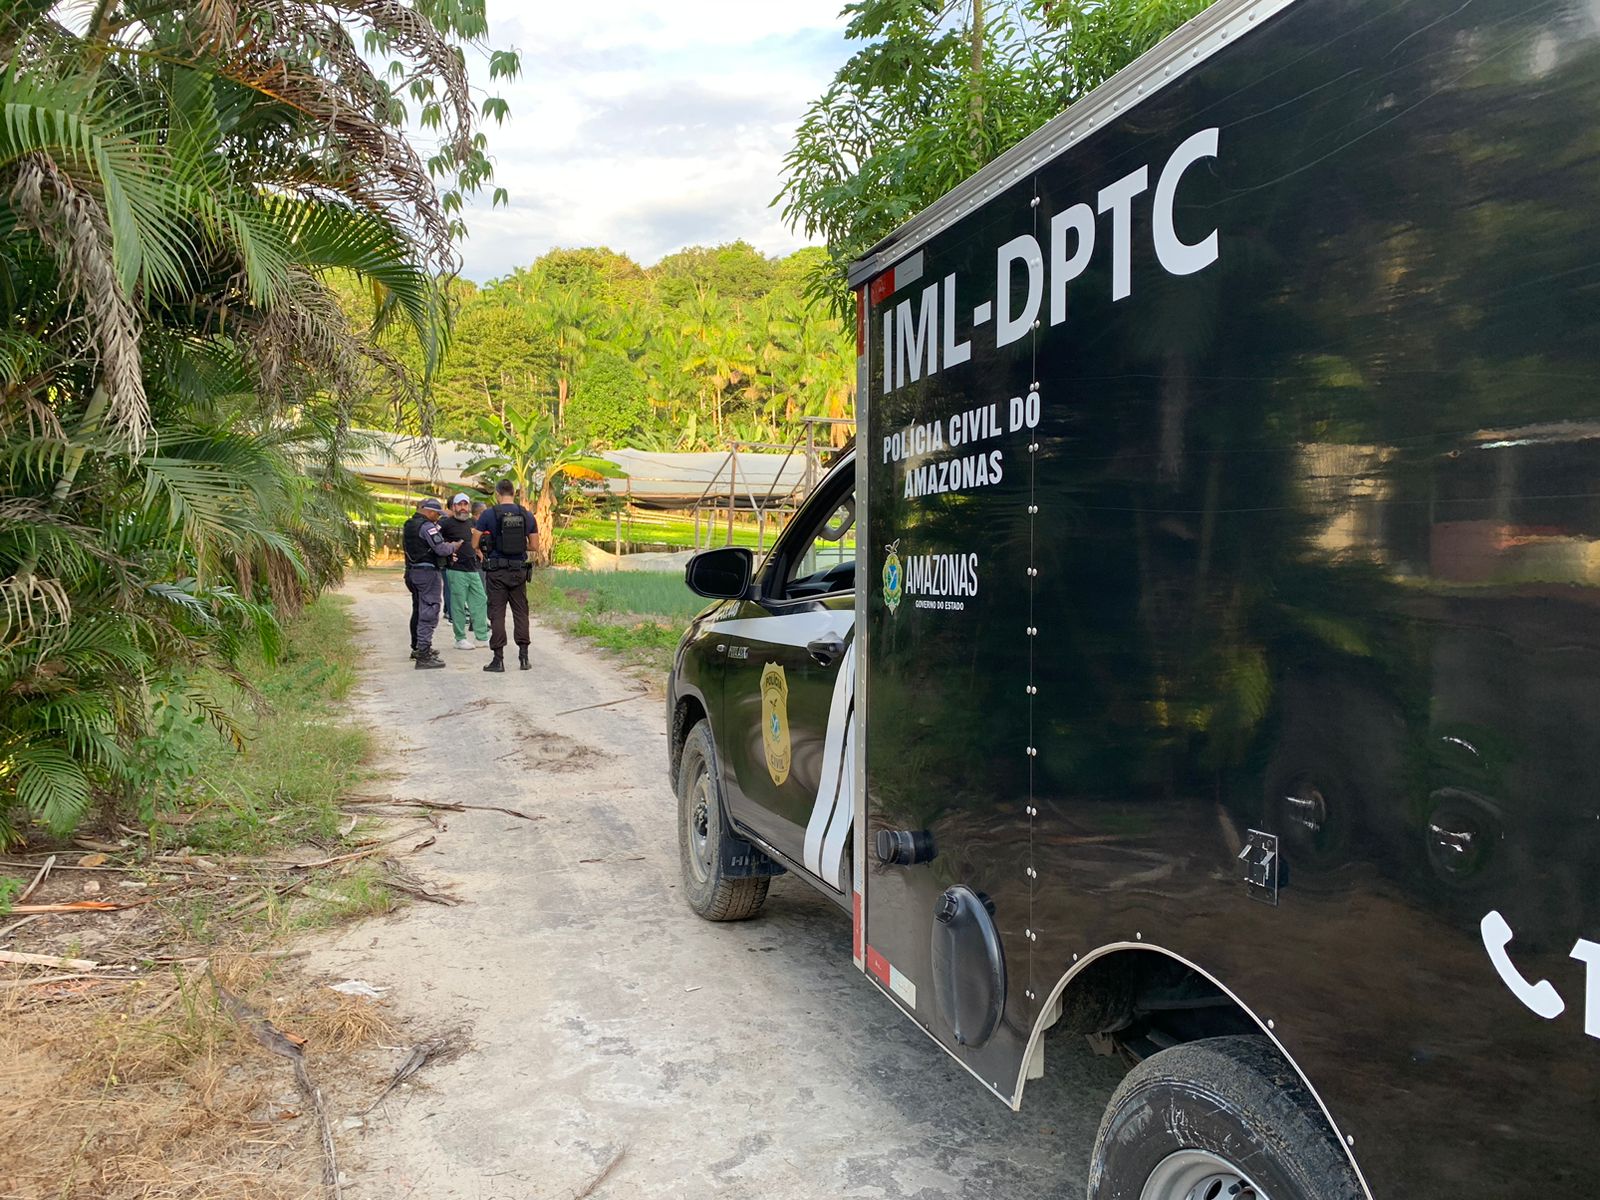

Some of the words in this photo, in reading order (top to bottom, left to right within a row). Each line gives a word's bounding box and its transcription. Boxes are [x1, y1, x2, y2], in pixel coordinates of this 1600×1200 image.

[883, 127, 1219, 395] IML-DPTC
[883, 418, 944, 464] POLÍCIA
[950, 403, 1002, 448] CIVIL
[1009, 391, 1041, 433] DO
[904, 450, 1003, 499] AMAZONAS
[905, 552, 979, 597] AMAZONAS
[915, 600, 936, 609] GOVERNO
[936, 600, 944, 609] DO
[945, 601, 964, 611] ESTADO
